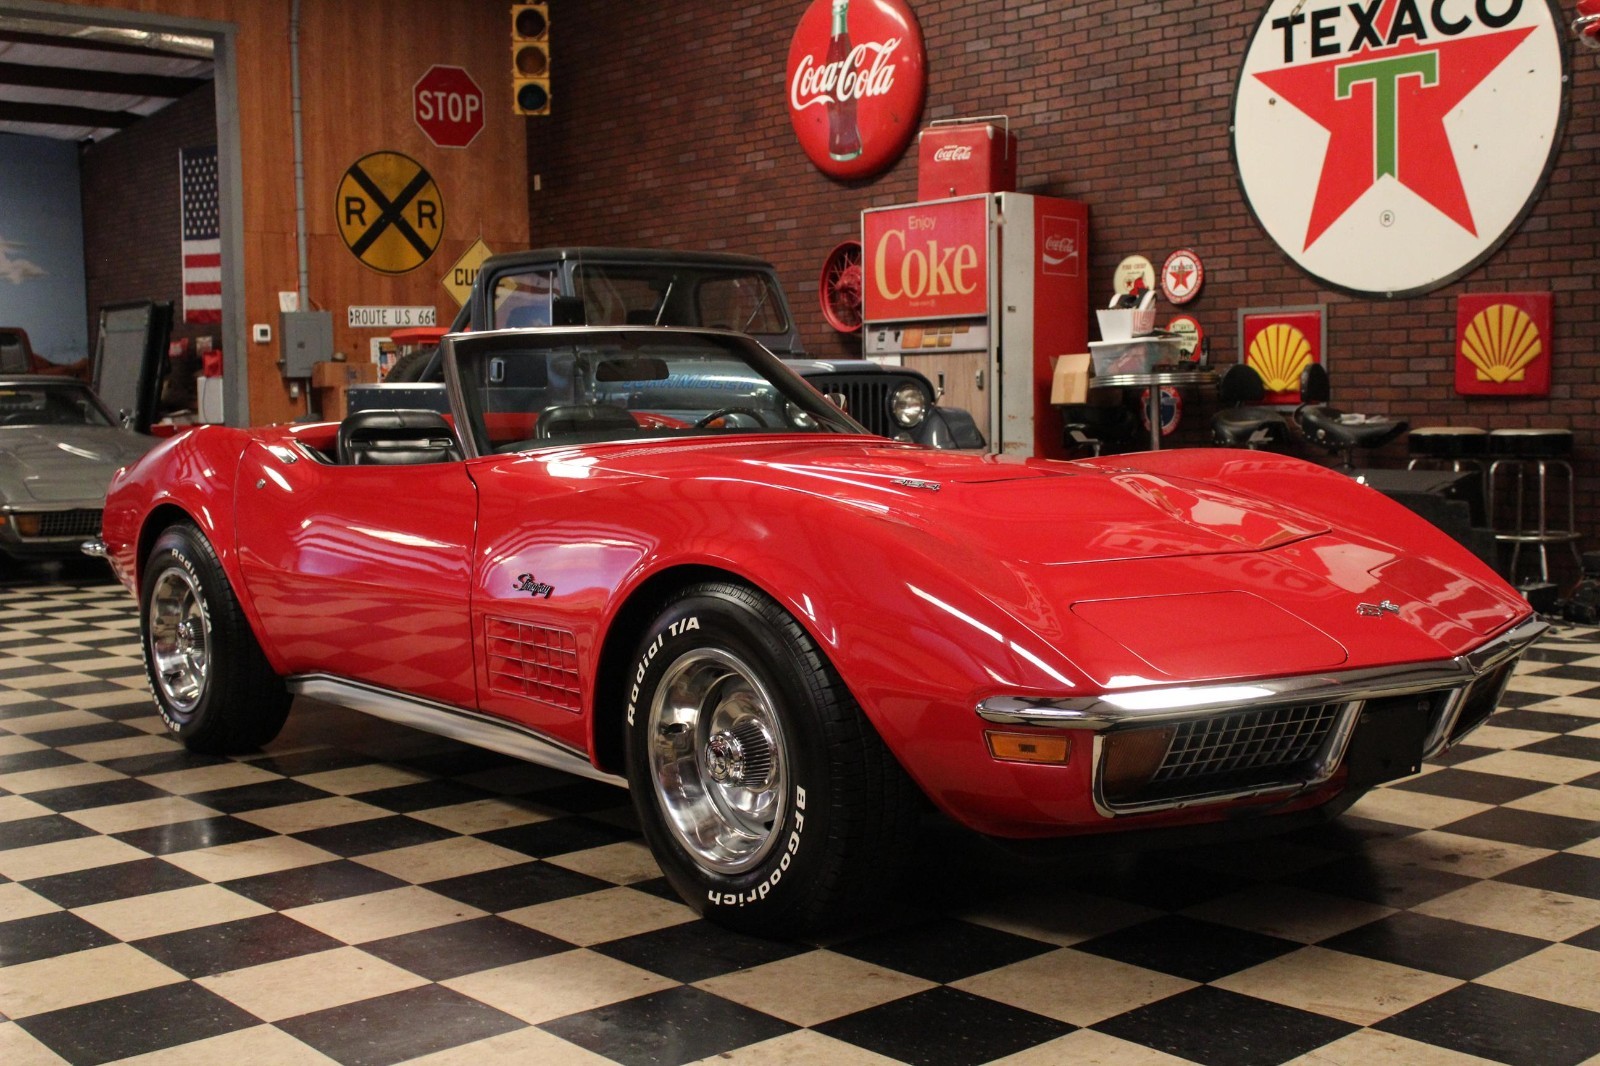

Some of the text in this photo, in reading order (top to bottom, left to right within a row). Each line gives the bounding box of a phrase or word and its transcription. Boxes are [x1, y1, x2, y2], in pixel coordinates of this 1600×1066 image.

[1272, 0, 1523, 63] TEXACO
[791, 37, 902, 110] Coca-Cola
[419, 90, 479, 122] STOP
[345, 197, 437, 229] R R
[908, 216, 936, 231] Enjoy
[875, 229, 978, 300] Coke
[354, 309, 431, 325] ROUTE U.S. 66
[512, 572, 555, 599] Stingray
[626, 616, 700, 727] Radial T/A
[708, 785, 806, 908] BFGoodrich
